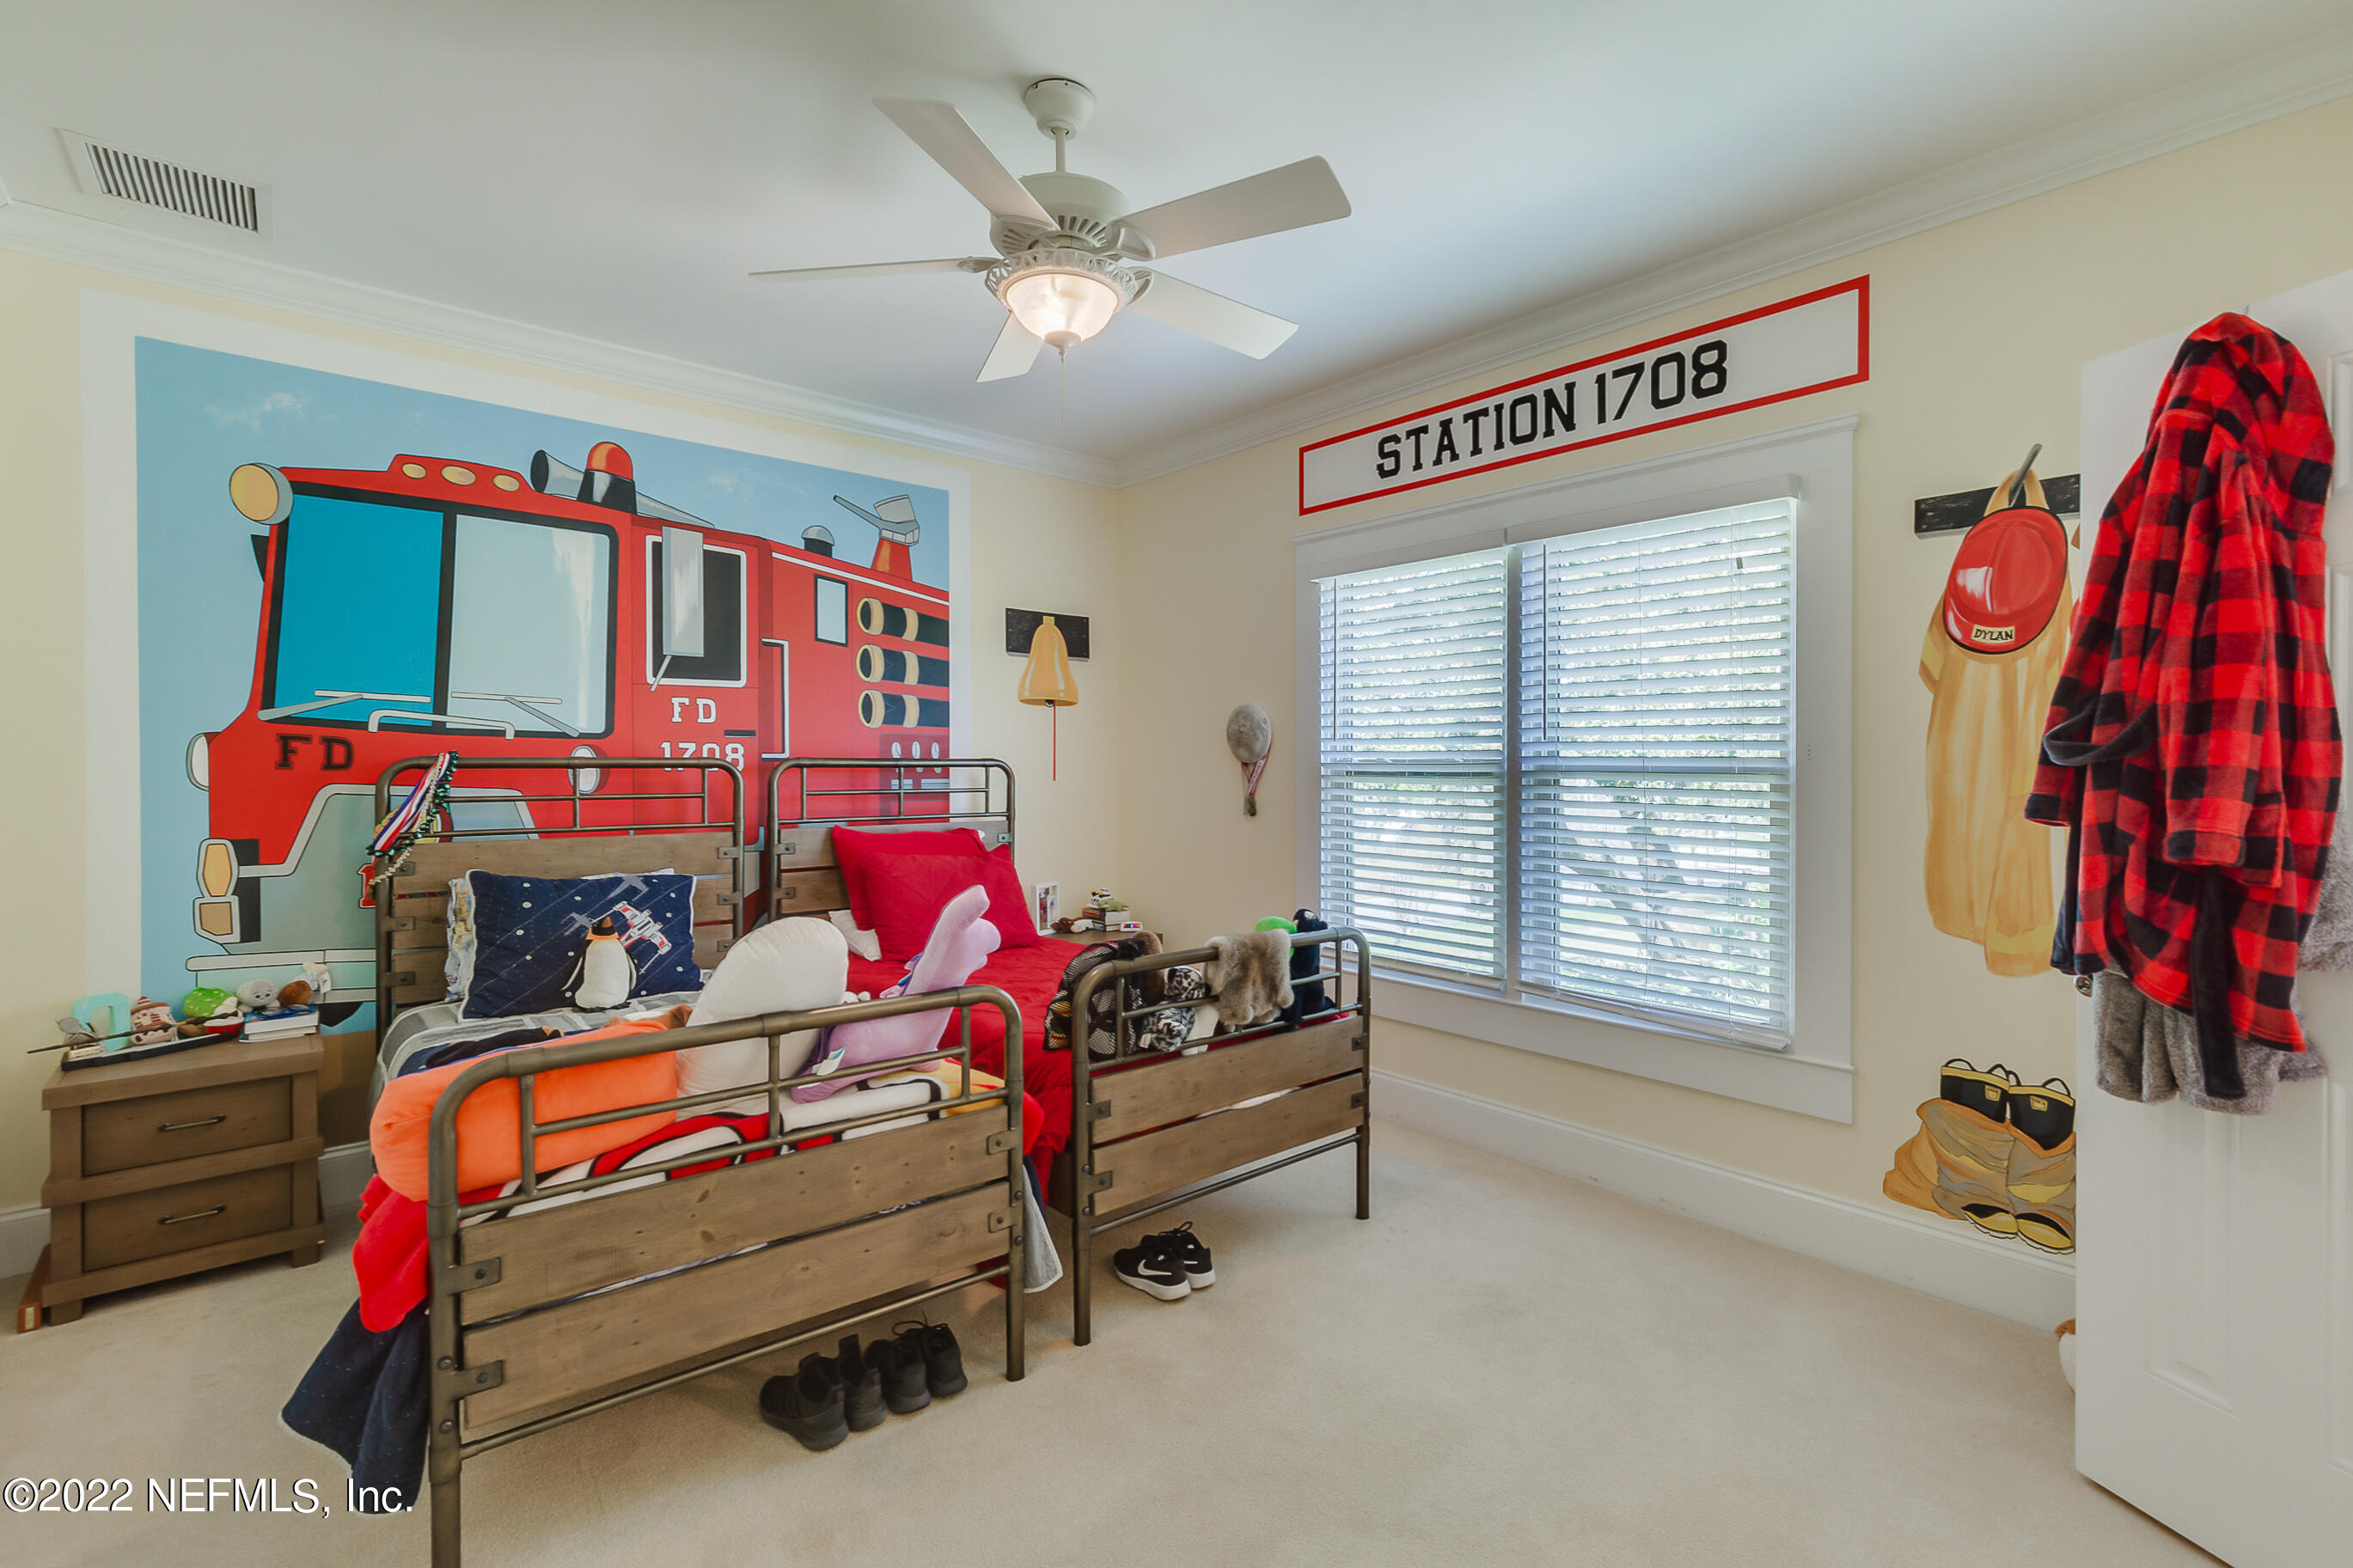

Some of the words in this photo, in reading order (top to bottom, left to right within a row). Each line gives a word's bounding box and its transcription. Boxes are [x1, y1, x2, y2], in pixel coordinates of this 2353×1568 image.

[1376, 381, 1576, 479] STATION
[1594, 339, 1728, 424] 1708
[1973, 628, 2014, 641] DYLAN
[660, 741, 745, 772] 1708
